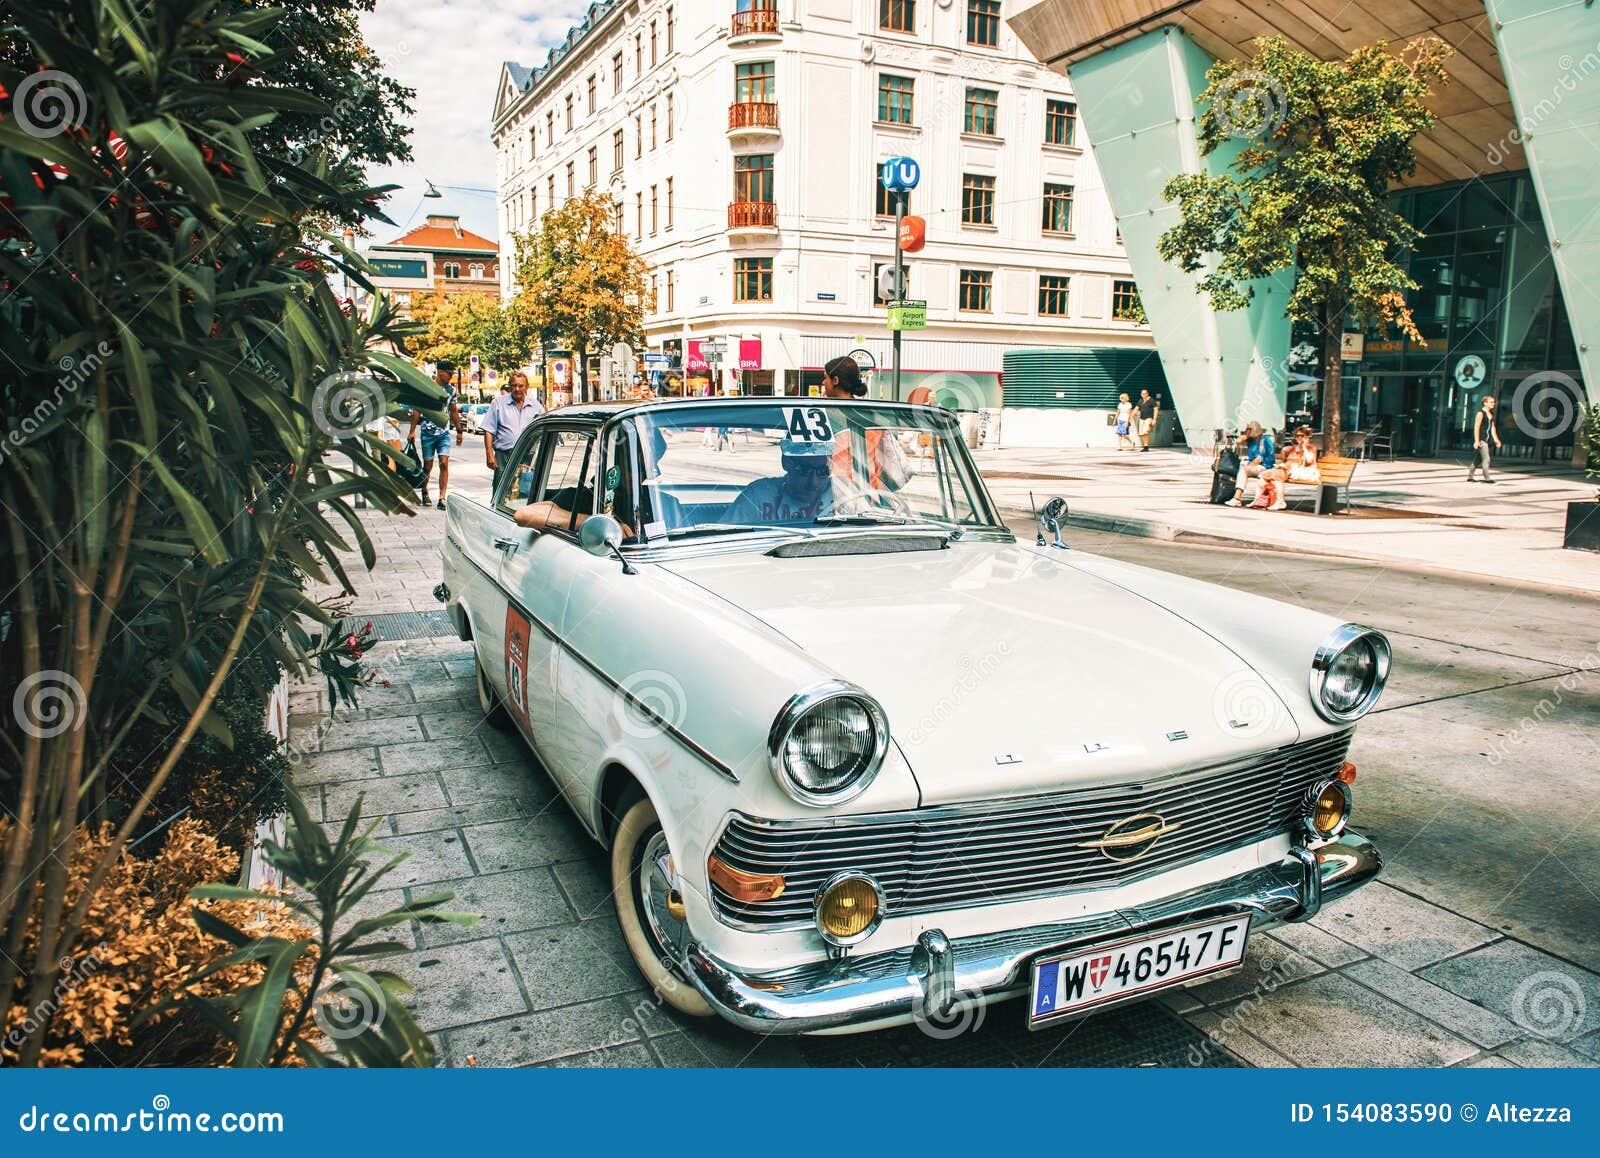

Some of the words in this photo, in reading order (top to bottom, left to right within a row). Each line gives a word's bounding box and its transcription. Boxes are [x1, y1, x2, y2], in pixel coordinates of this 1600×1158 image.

[900, 164, 916, 183] U
[902, 312, 924, 320] Airport
[902, 320, 924, 328] Express
[691, 360, 709, 368] BIPA
[740, 360, 759, 368] BIPA
[789, 407, 833, 442] 43
[1065, 961, 1089, 1002] W
[1041, 994, 1051, 1007] A
